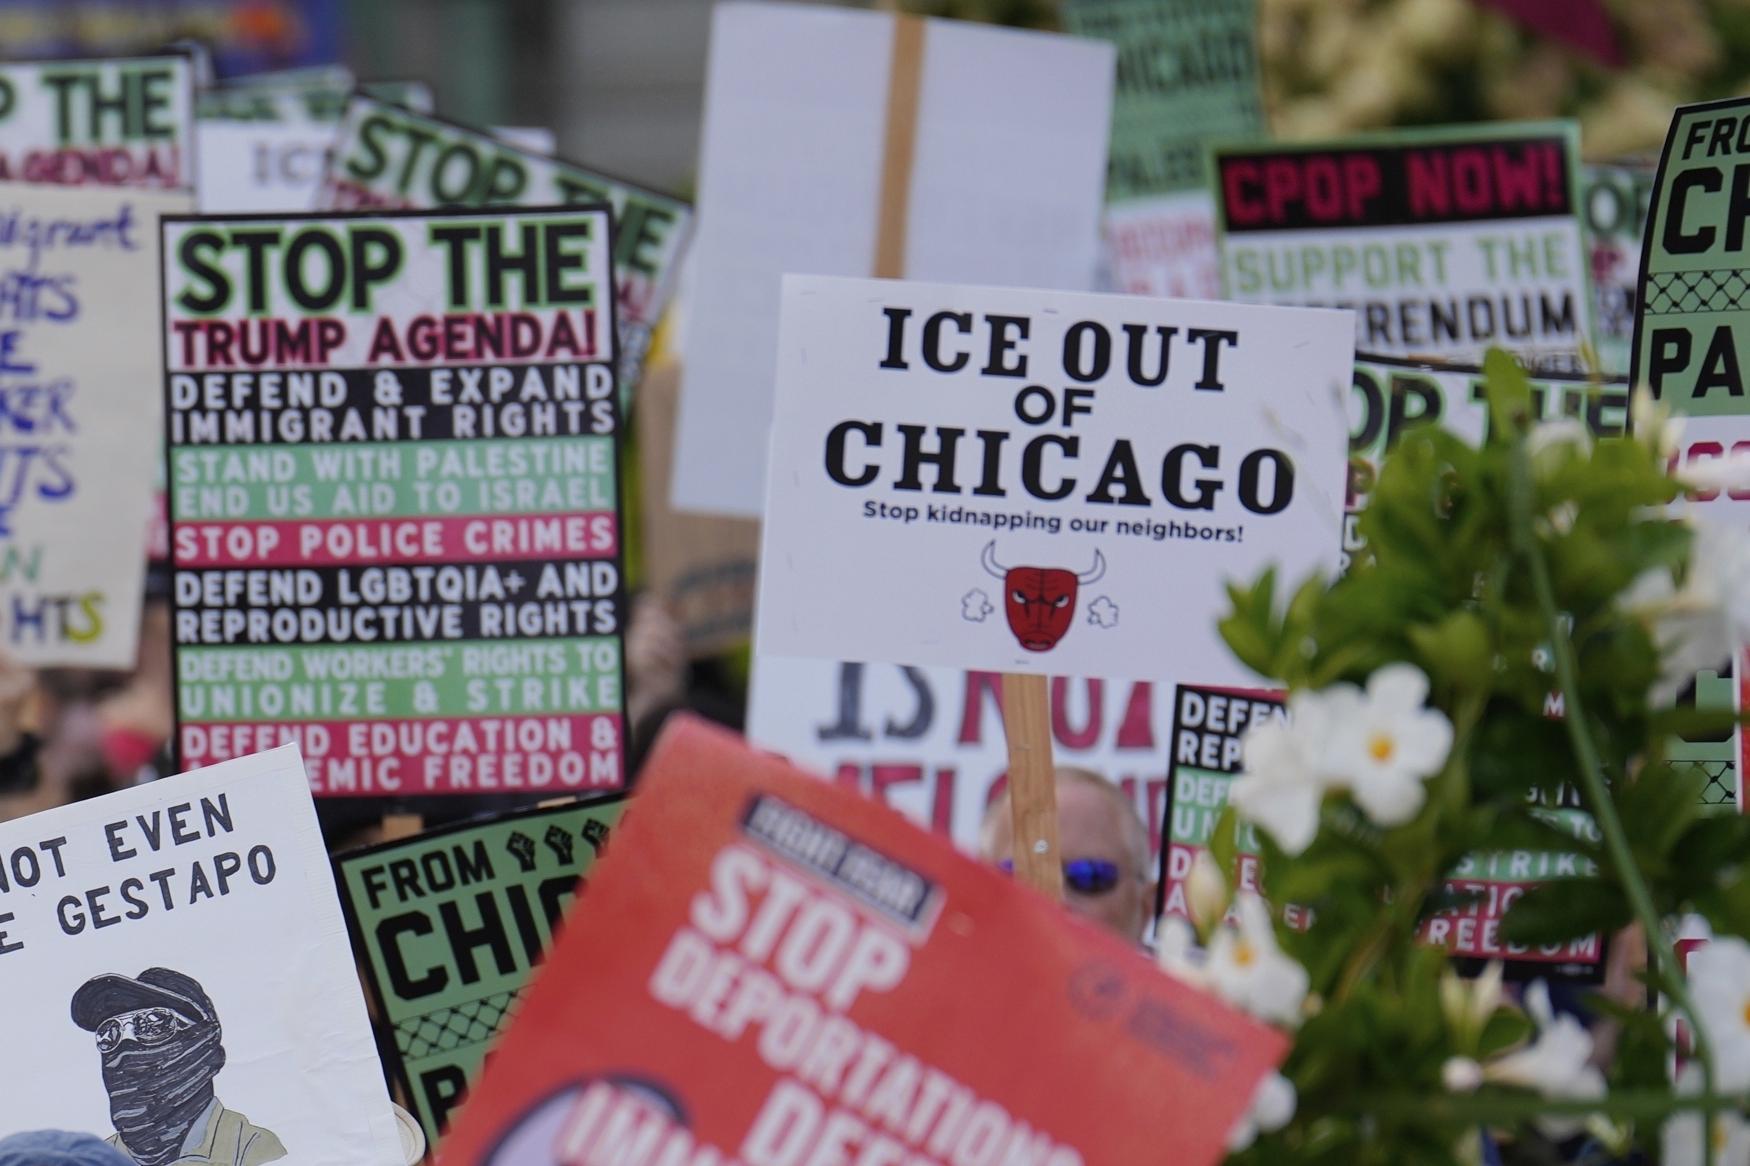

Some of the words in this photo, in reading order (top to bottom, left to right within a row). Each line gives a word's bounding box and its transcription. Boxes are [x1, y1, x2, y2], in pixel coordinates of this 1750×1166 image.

[43, 68, 175, 142] THE
[347, 112, 530, 206] STOP
[1222, 154, 1382, 228] CPOP
[1404, 142, 1565, 218] NOW!
[176, 224, 404, 315] STOP
[429, 218, 593, 309] THE
[1235, 239, 1451, 294] SUPPORT
[1477, 232, 1570, 283] THE
[173, 317, 346, 368] TRUMP
[367, 310, 597, 364] AGENDA!
[878, 306, 1032, 379] ICE
[1061, 319, 1239, 393] OUT
[171, 372, 347, 410] DEFEND
[374, 370, 403, 405] &
[431, 364, 614, 405] EXPAND
[1014, 384, 1096, 428] OF
[172, 405, 427, 444] IMMIGRANT
[453, 401, 615, 439] RIGHTS
[177, 451, 297, 486] STAND
[312, 447, 401, 480] WITH
[416, 442, 608, 479] PALESTINE
[823, 419, 1296, 517] CHICAGO
[177, 485, 249, 519] END
[267, 484, 313, 516] US
[333, 481, 396, 514] AID
[413, 480, 462, 513] TO
[479, 476, 609, 512] ISRAEL
[174, 526, 281, 561] STOP
[300, 520, 444, 558] POLICE
[464, 515, 613, 554] CRIMES
[863, 500, 920, 524] Stop
[927, 503, 1062, 534] kidnapping
[1069, 514, 1110, 534] our
[1116, 516, 1246, 543] neighbors!
[174, 569, 323, 608] DEFEND
[338, 565, 527, 607] LGBTQIA+
[537, 561, 619, 599] AND
[176, 606, 464, 644] REPRODUCTIVE
[480, 600, 617, 637] RIGHTS
[180, 652, 294, 683] DEFEND
[301, 647, 456, 681] WORKERS'
[463, 644, 566, 677] RIGHTS
[577, 642, 617, 672] TO
[179, 682, 387, 718] UNIONIZE
[414, 680, 440, 713] &
[466, 673, 618, 712] STRIKE
[182, 725, 331, 760] DEFEND
[350, 717, 573, 756] EDUCATION
[591, 716, 617, 750] &
[425, 750, 620, 789] FREEDOM
[103, 792, 234, 863] EVEN
[56, 843, 277, 936] GESTAPO
[360, 838, 497, 911] FROM
[690, 844, 911, 1008] STOP
